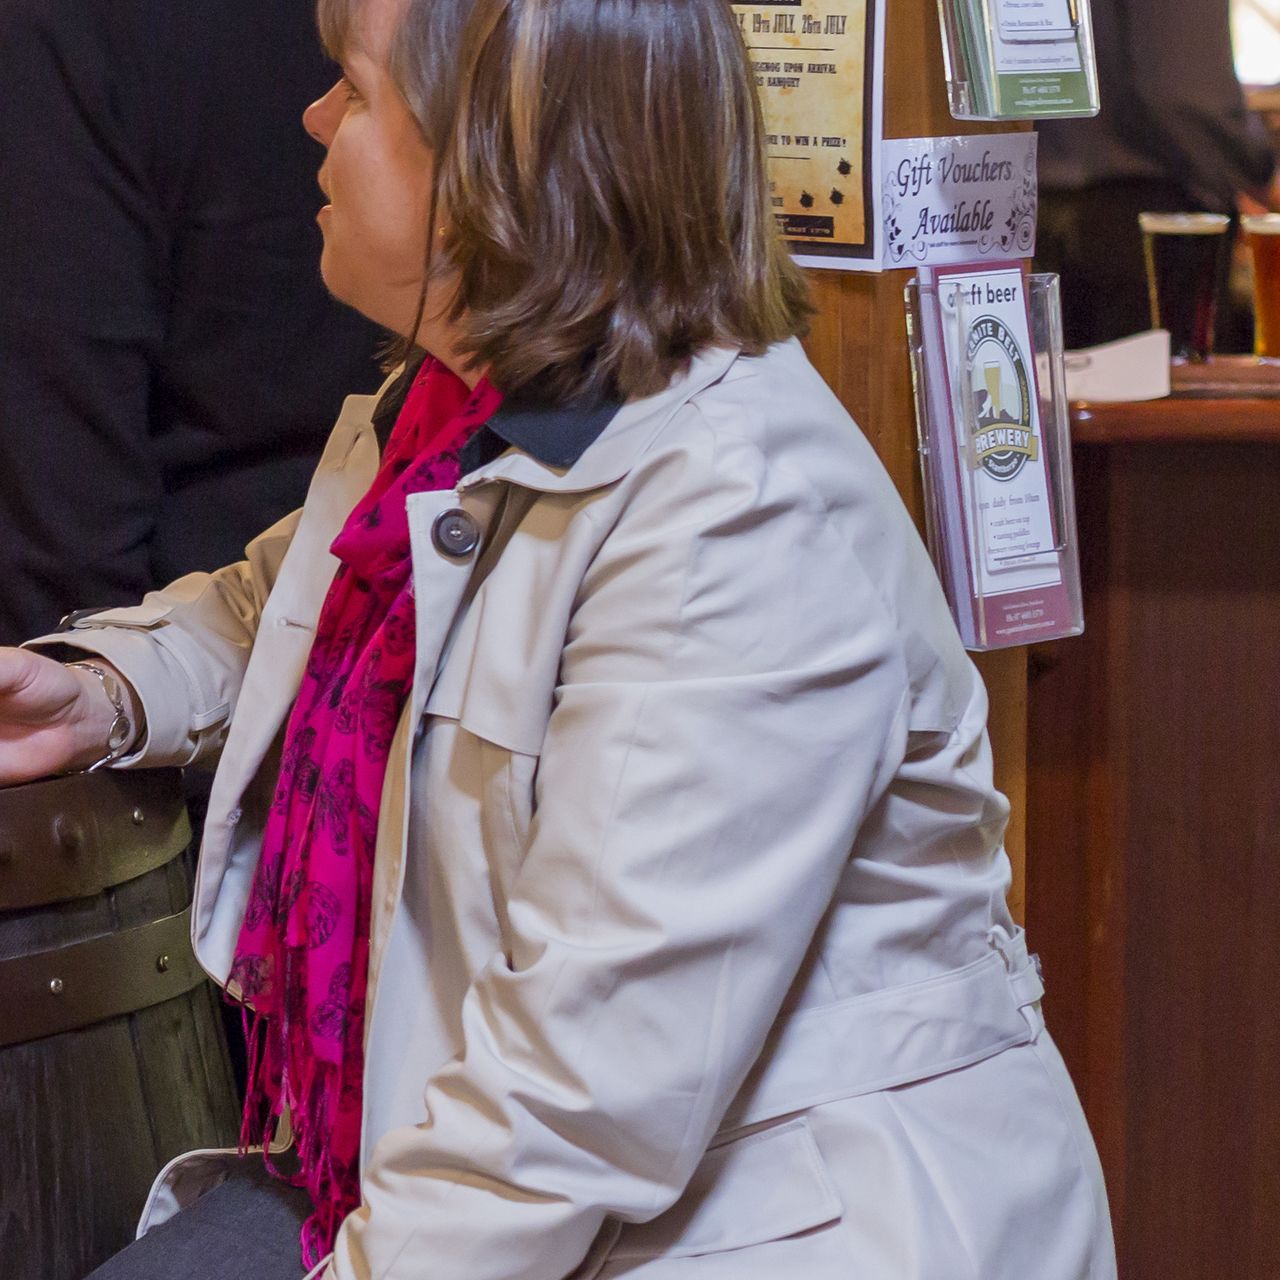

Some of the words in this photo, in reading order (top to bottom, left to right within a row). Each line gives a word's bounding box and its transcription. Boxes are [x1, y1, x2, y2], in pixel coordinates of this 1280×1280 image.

[824, 15, 847, 34] JULY
[897, 153, 932, 197] Gift
[938, 151, 1012, 183] Vouchers
[912, 200, 994, 240] Available
[986, 283, 1017, 304] beer
[998, 327, 1019, 362] BELT
